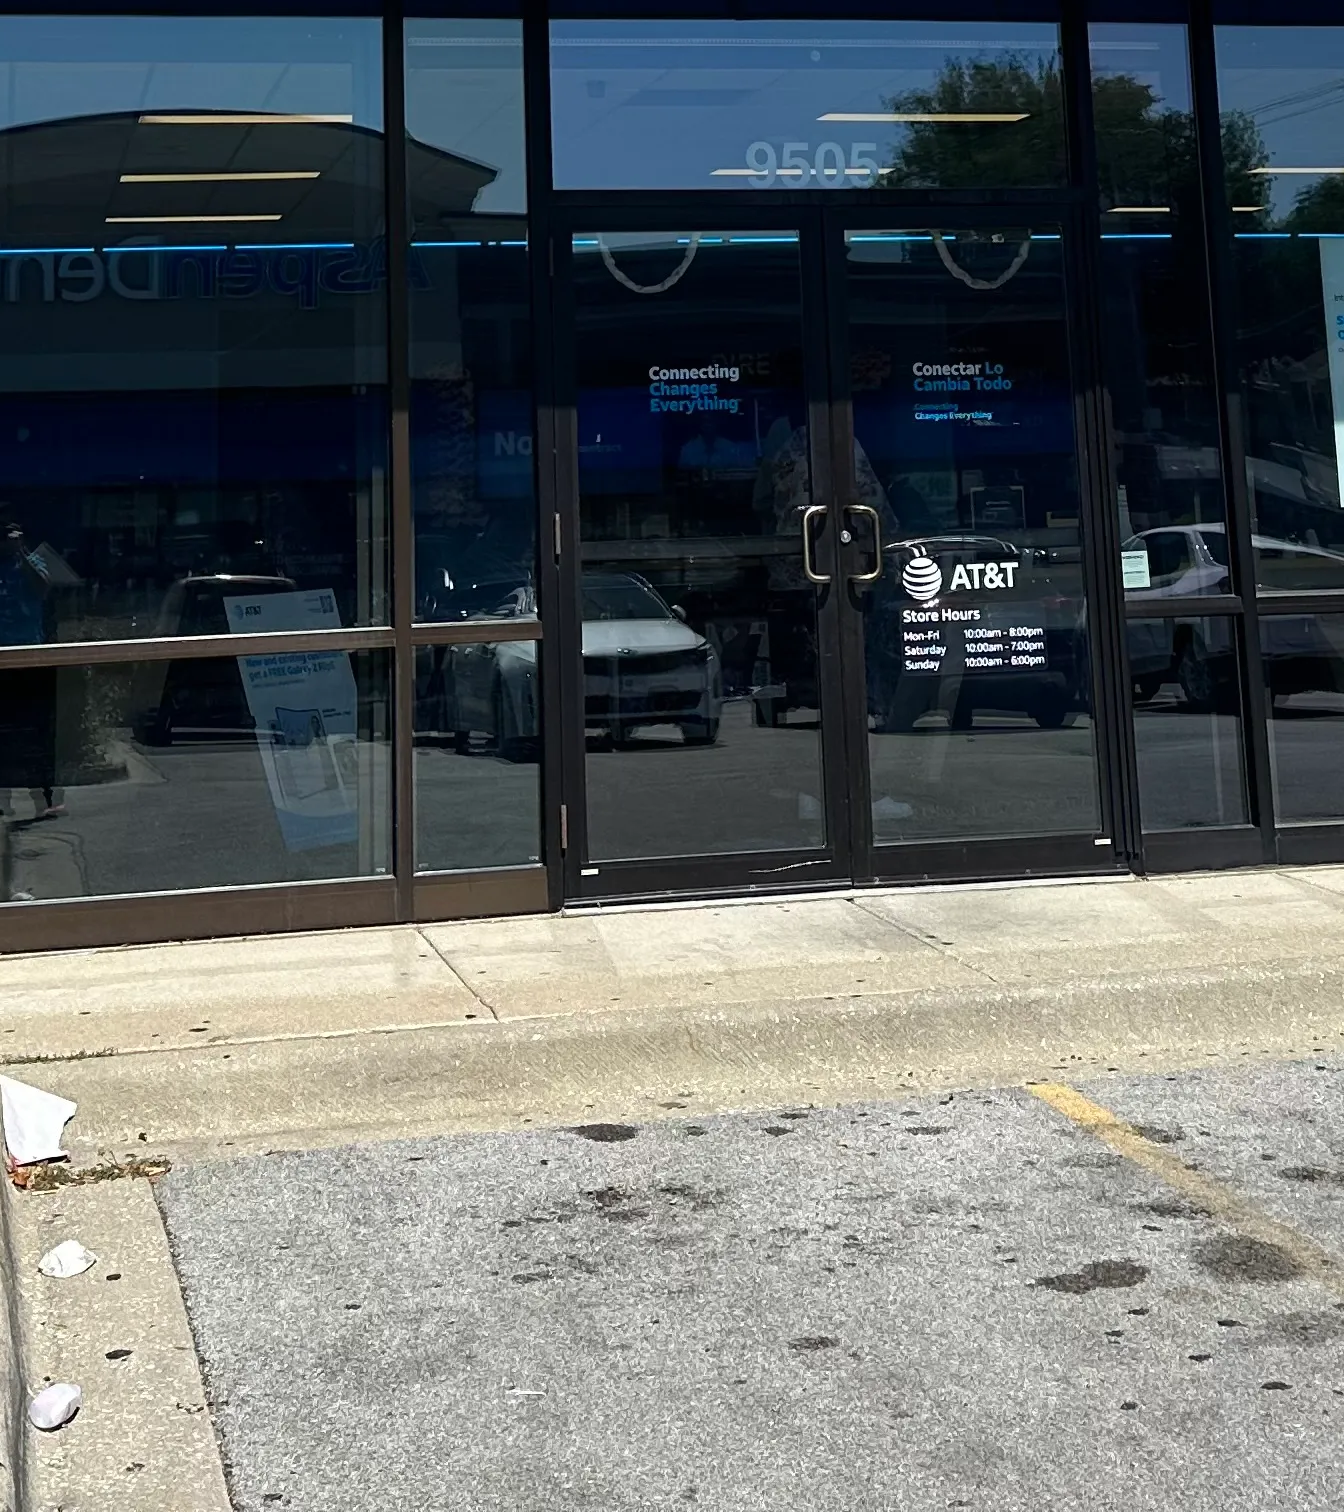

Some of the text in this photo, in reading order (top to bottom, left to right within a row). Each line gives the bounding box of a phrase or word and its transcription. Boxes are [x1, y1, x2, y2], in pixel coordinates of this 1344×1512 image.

[745, 141, 879, 189] 9505
[649, 363, 739, 382] Connecting
[912, 360, 1004, 377] Conectar Lo
[649, 381, 718, 398] Changes
[913, 376, 1013, 392] Cambia Todo
[650, 396, 740, 415] Everything
[914, 411, 993, 422] Changes Everything
[950, 562, 1019, 591] AT&T
[245, 605, 262, 616] AT&T
[903, 608, 981, 623] Store Hours
[903, 630, 940, 642] Mon-Fri
[963, 628, 1002, 639] 10:00am
[1009, 626, 1044, 638] 8:00pm
[904, 644, 947, 657] Saturday
[964, 642, 1003, 653] 10:00am
[1011, 640, 1045, 653] 7:00pm
[905, 658, 941, 672] Sunday
[964, 656, 1003, 668] 10:00am
[1011, 654, 1046, 667] 6:00pm
